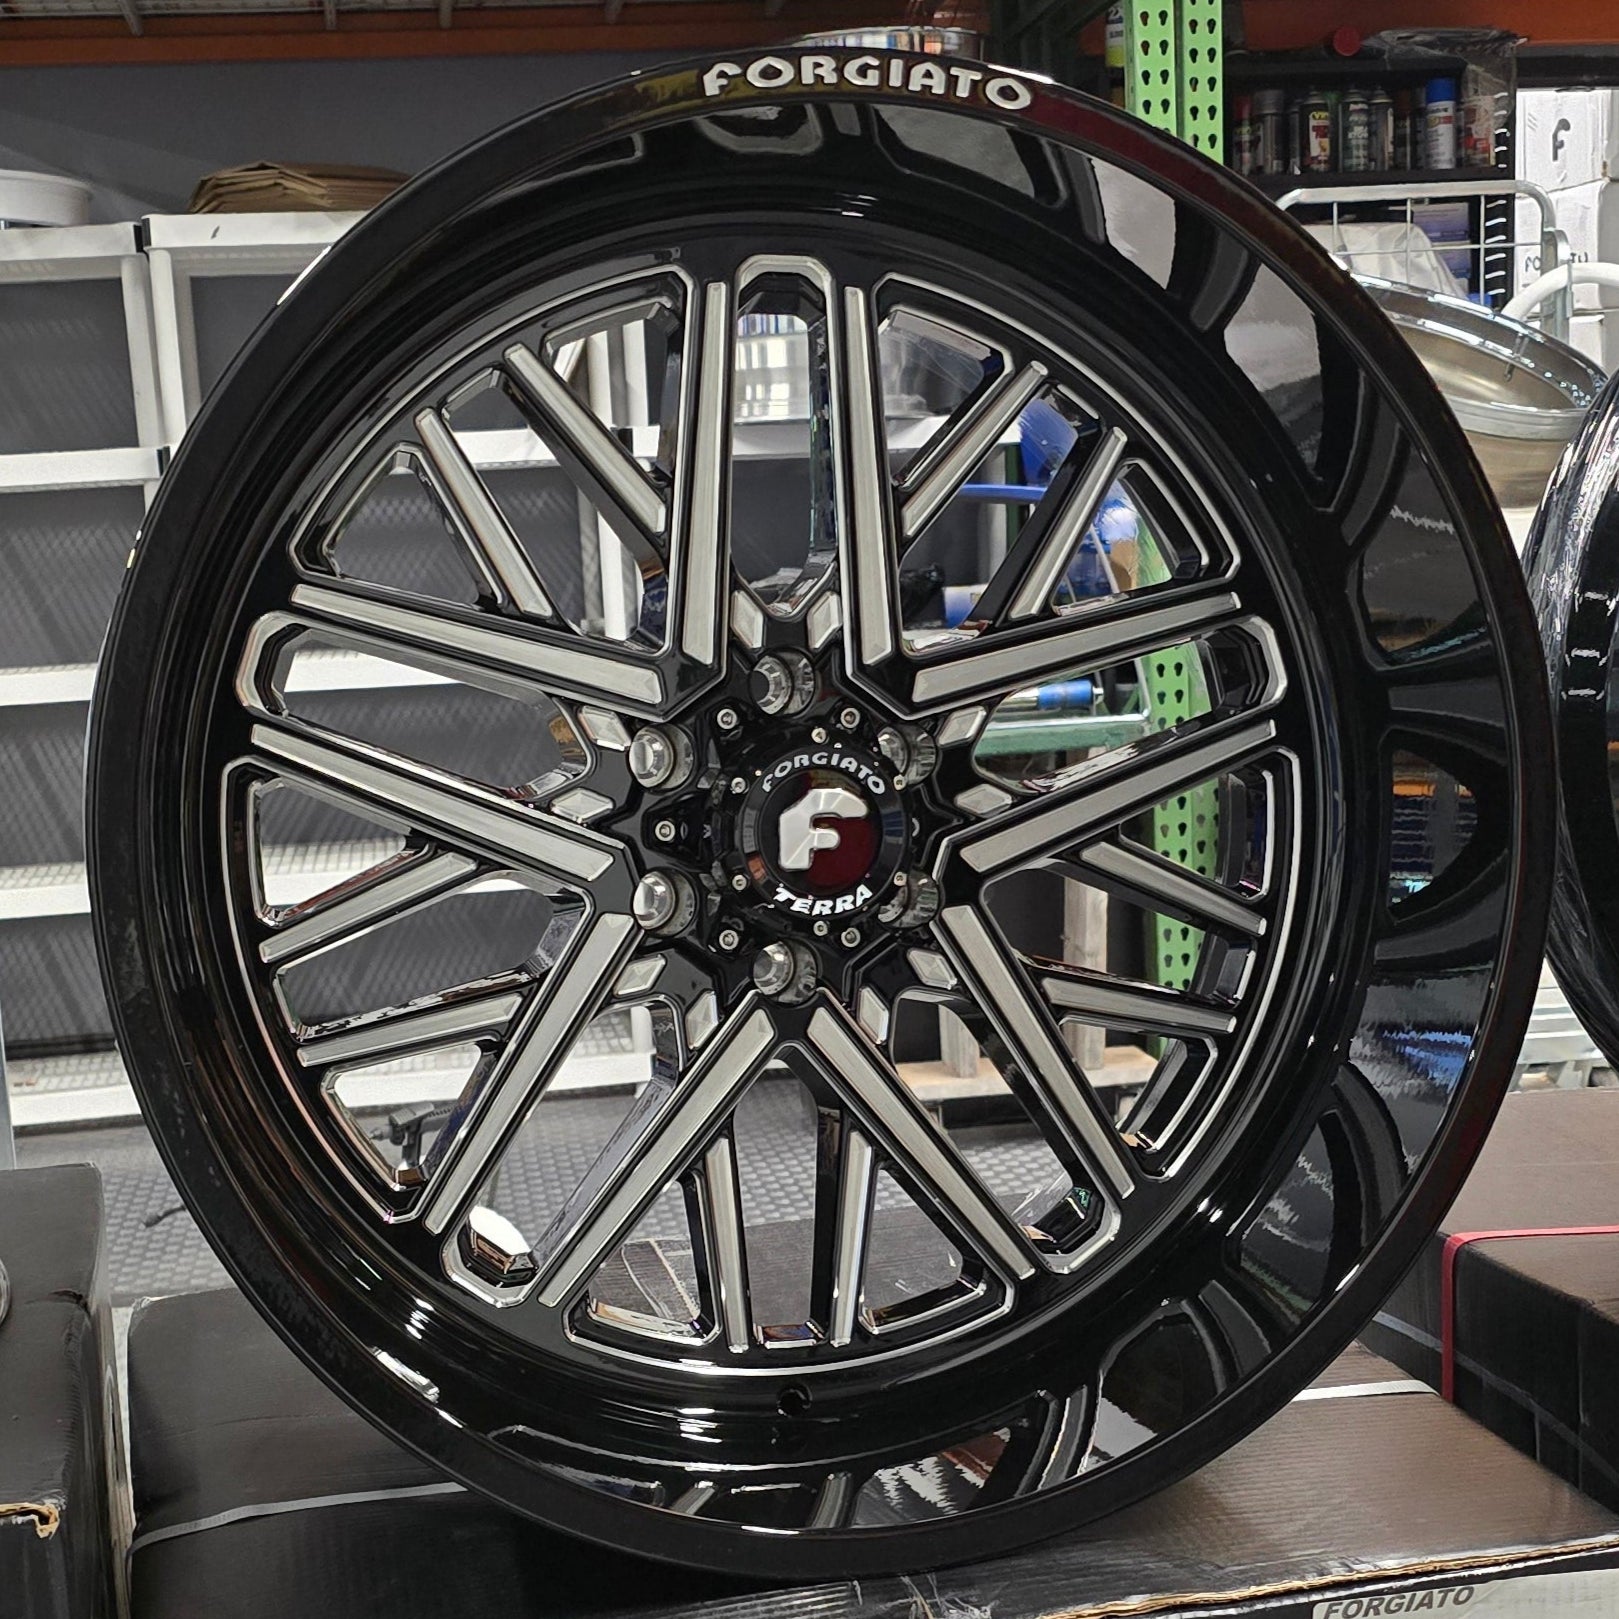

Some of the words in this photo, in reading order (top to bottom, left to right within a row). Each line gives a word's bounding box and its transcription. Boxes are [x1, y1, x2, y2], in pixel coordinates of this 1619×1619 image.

[703, 56, 1031, 109] FORGIATO
[762, 752, 886, 795] FORGIATO
[779, 788, 868, 870] F
[773, 884, 873, 916] TERRA
[1323, 1586, 1474, 1619] FORGIATO
